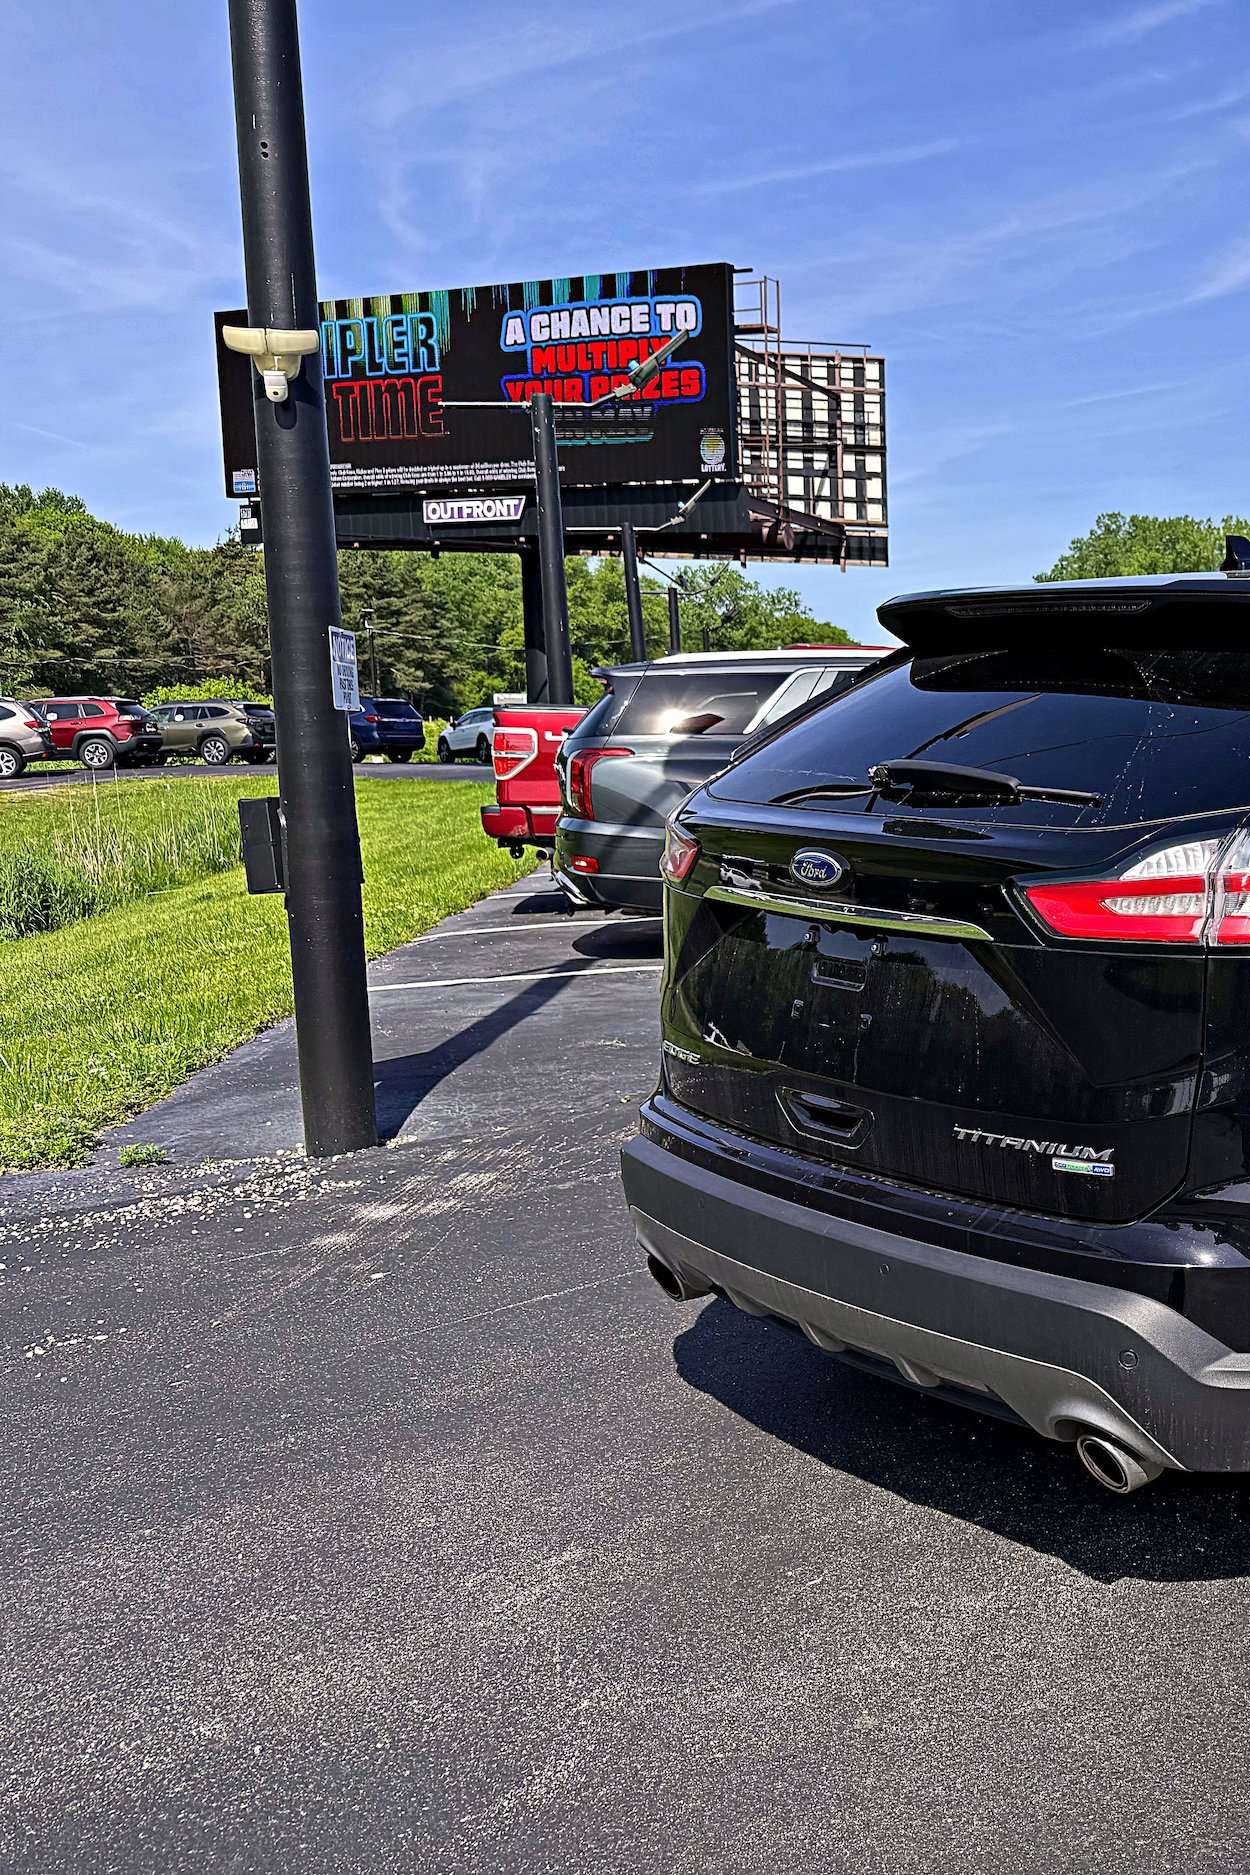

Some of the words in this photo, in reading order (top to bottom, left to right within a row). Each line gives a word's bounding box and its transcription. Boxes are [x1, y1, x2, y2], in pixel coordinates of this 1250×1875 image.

[505, 317, 526, 346] A
[530, 303, 650, 342] CHANCE
[656, 302, 697, 332] TO
[321, 311, 441, 379] IPLER
[590, 368, 700, 402] PRZES
[332, 374, 444, 442] TIME
[427, 498, 520, 521] OUTFRONT
[333, 635, 355, 660] NOTICE
[800, 858, 828, 879] Ford
[952, 1125, 1115, 1162] TITANIUM
